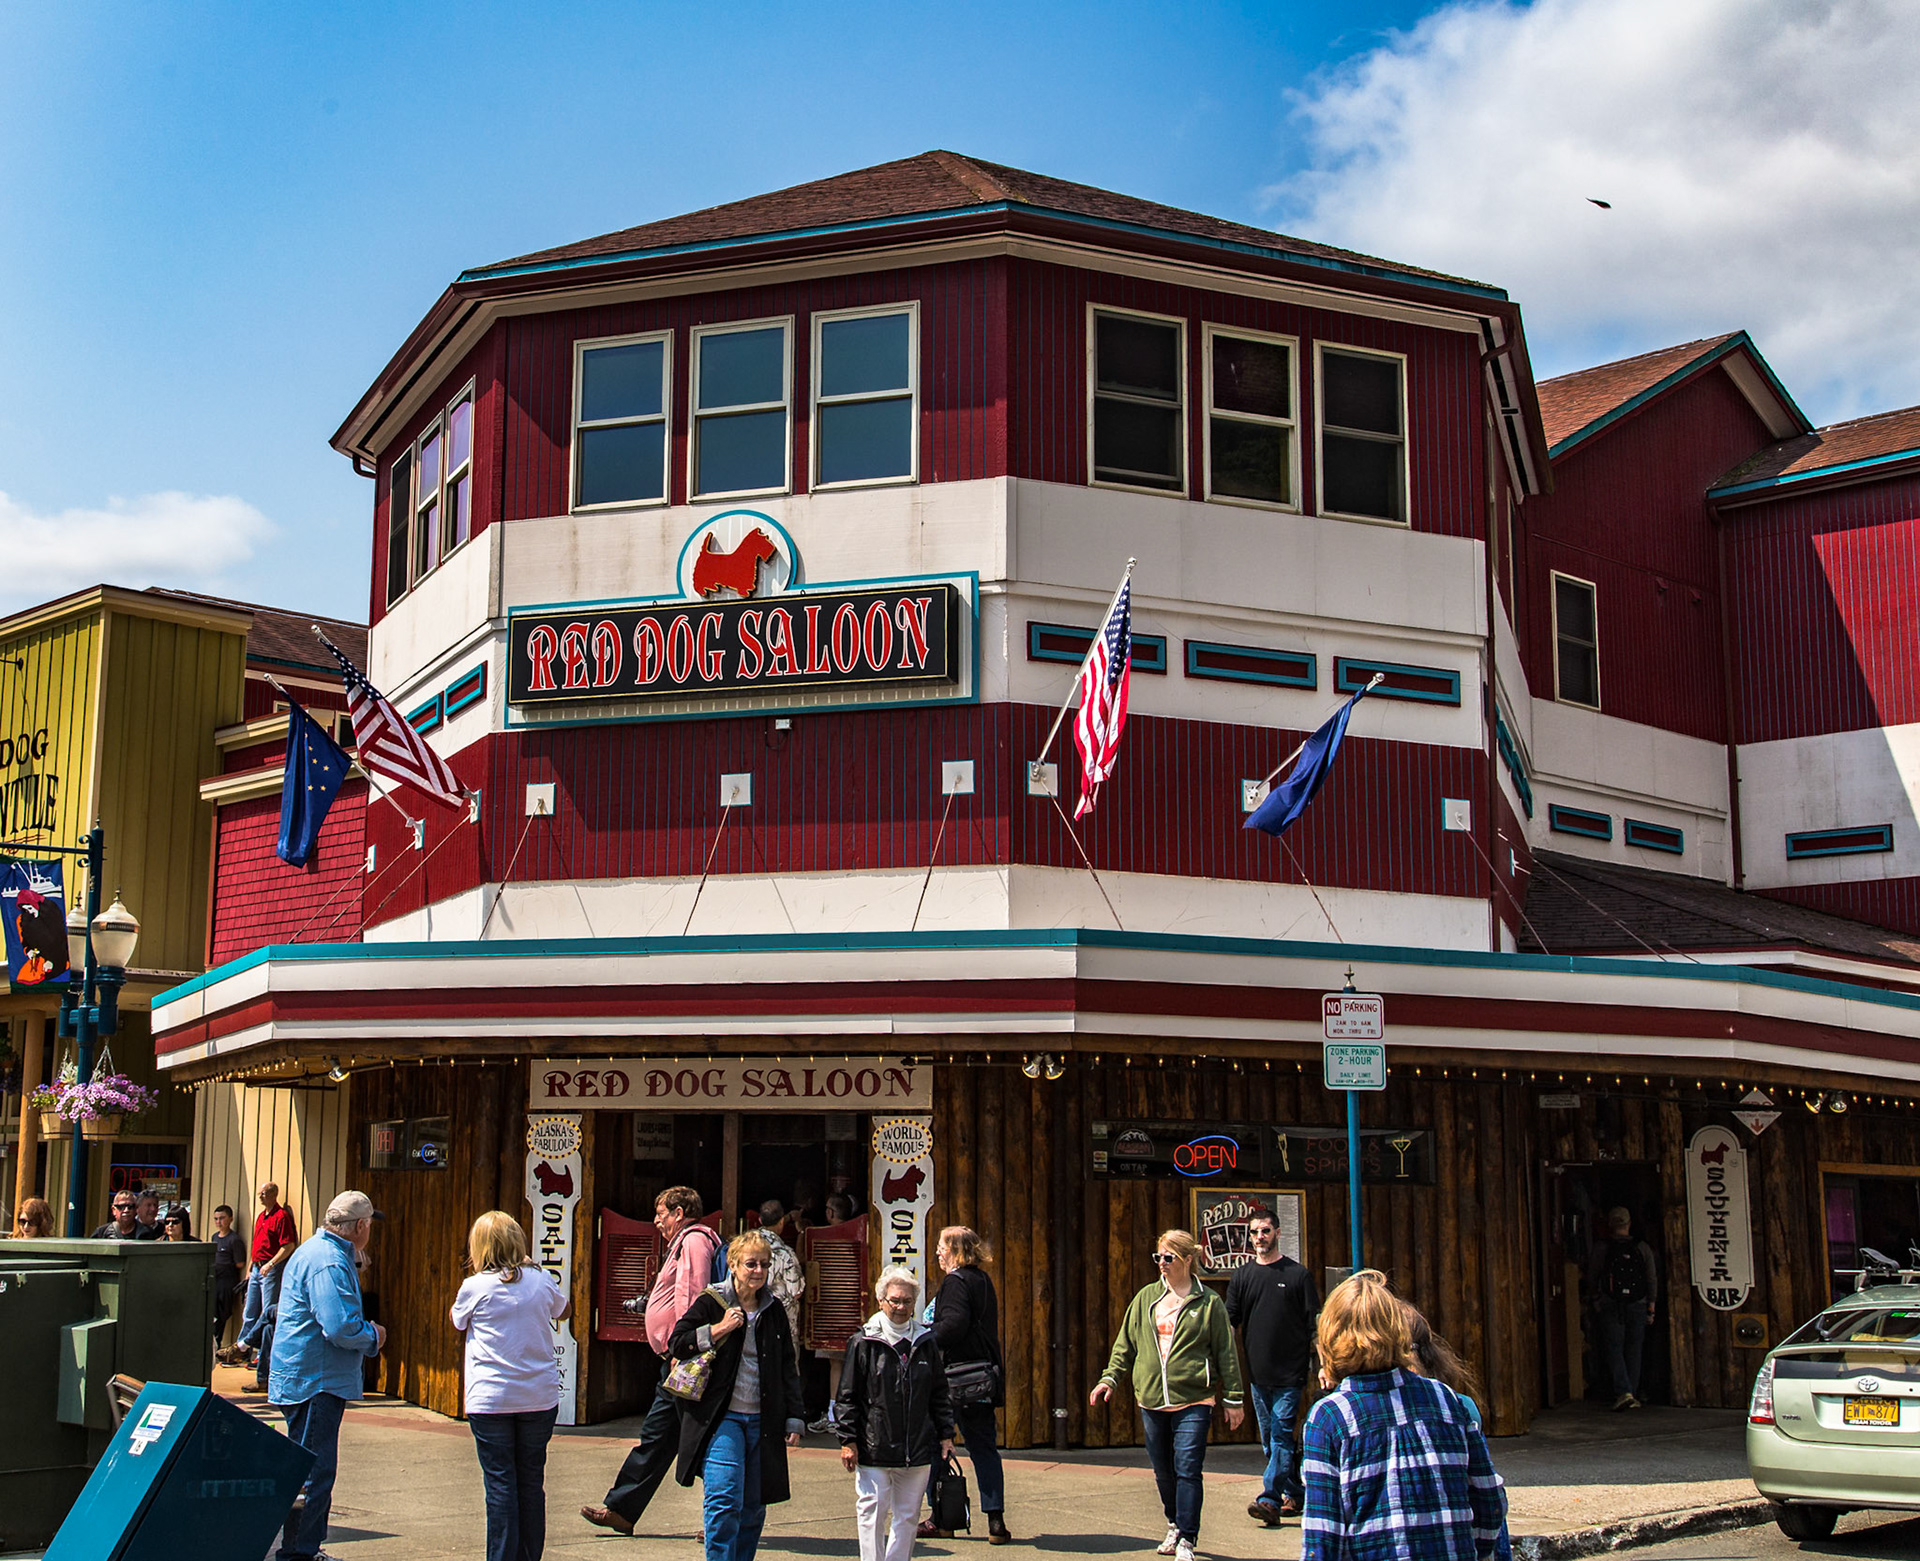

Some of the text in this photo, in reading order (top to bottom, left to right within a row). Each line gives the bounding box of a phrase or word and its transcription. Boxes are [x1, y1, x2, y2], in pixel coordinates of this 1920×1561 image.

[527, 597, 932, 691] RED DOG SALOON
[1327, 1001, 1378, 1014] NO PARKING
[1330, 1047, 1380, 1057] ZONE PARKING
[1338, 1056, 1372, 1065] 2-HOUR
[543, 1067, 917, 1098] RED DOG SALOON
[534, 1123, 575, 1138] ALASKA'S
[883, 1126, 923, 1140] WORLD
[534, 1138, 575, 1152] FABULOUS
[881, 1140, 925, 1155] FAMOUS
[1306, 1137, 1381, 1154] FOO &
[1173, 1144, 1237, 1169] OPEN
[1120, 1163, 1148, 1172] ON TAP
[1201, 1200, 1234, 1228] RED
[1704, 1166, 1732, 1282] SOUVENIR
[1707, 1288, 1743, 1307] BAR
[1846, 1405, 1897, 1419] EWT 877
